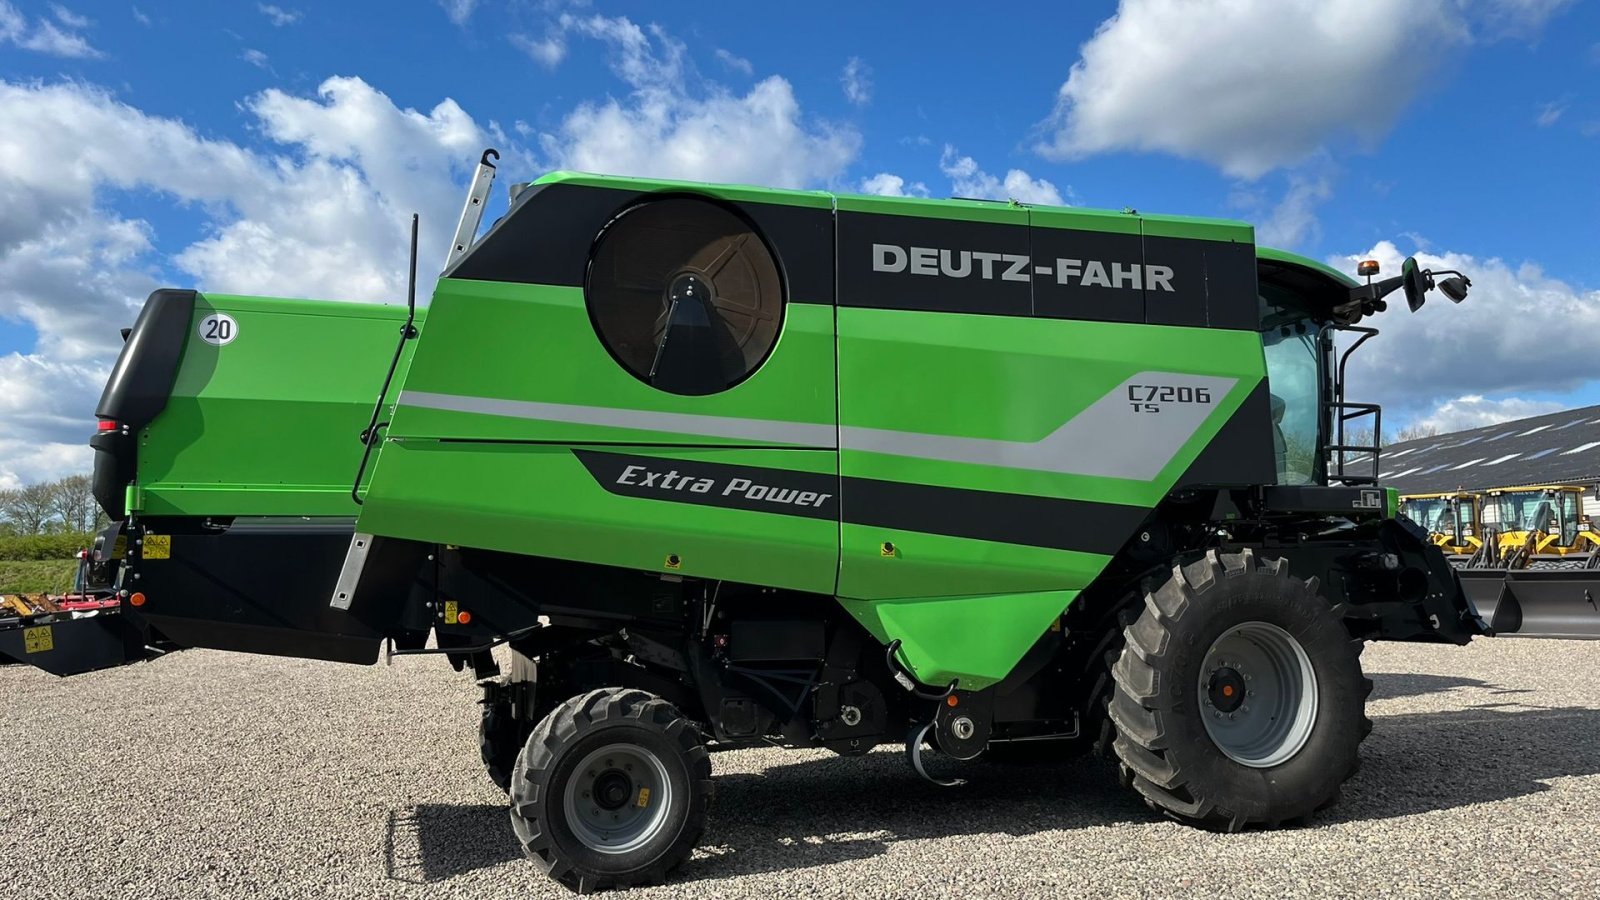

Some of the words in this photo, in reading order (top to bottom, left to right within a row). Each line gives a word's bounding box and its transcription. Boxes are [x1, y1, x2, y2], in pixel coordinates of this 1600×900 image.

[872, 243, 1175, 292] DEUTZ-FAHR
[205, 319, 231, 340] 20
[1128, 385, 1211, 403] C7206
[1130, 403, 1160, 413] TS
[616, 465, 715, 493] Extra
[721, 478, 833, 508] Power
